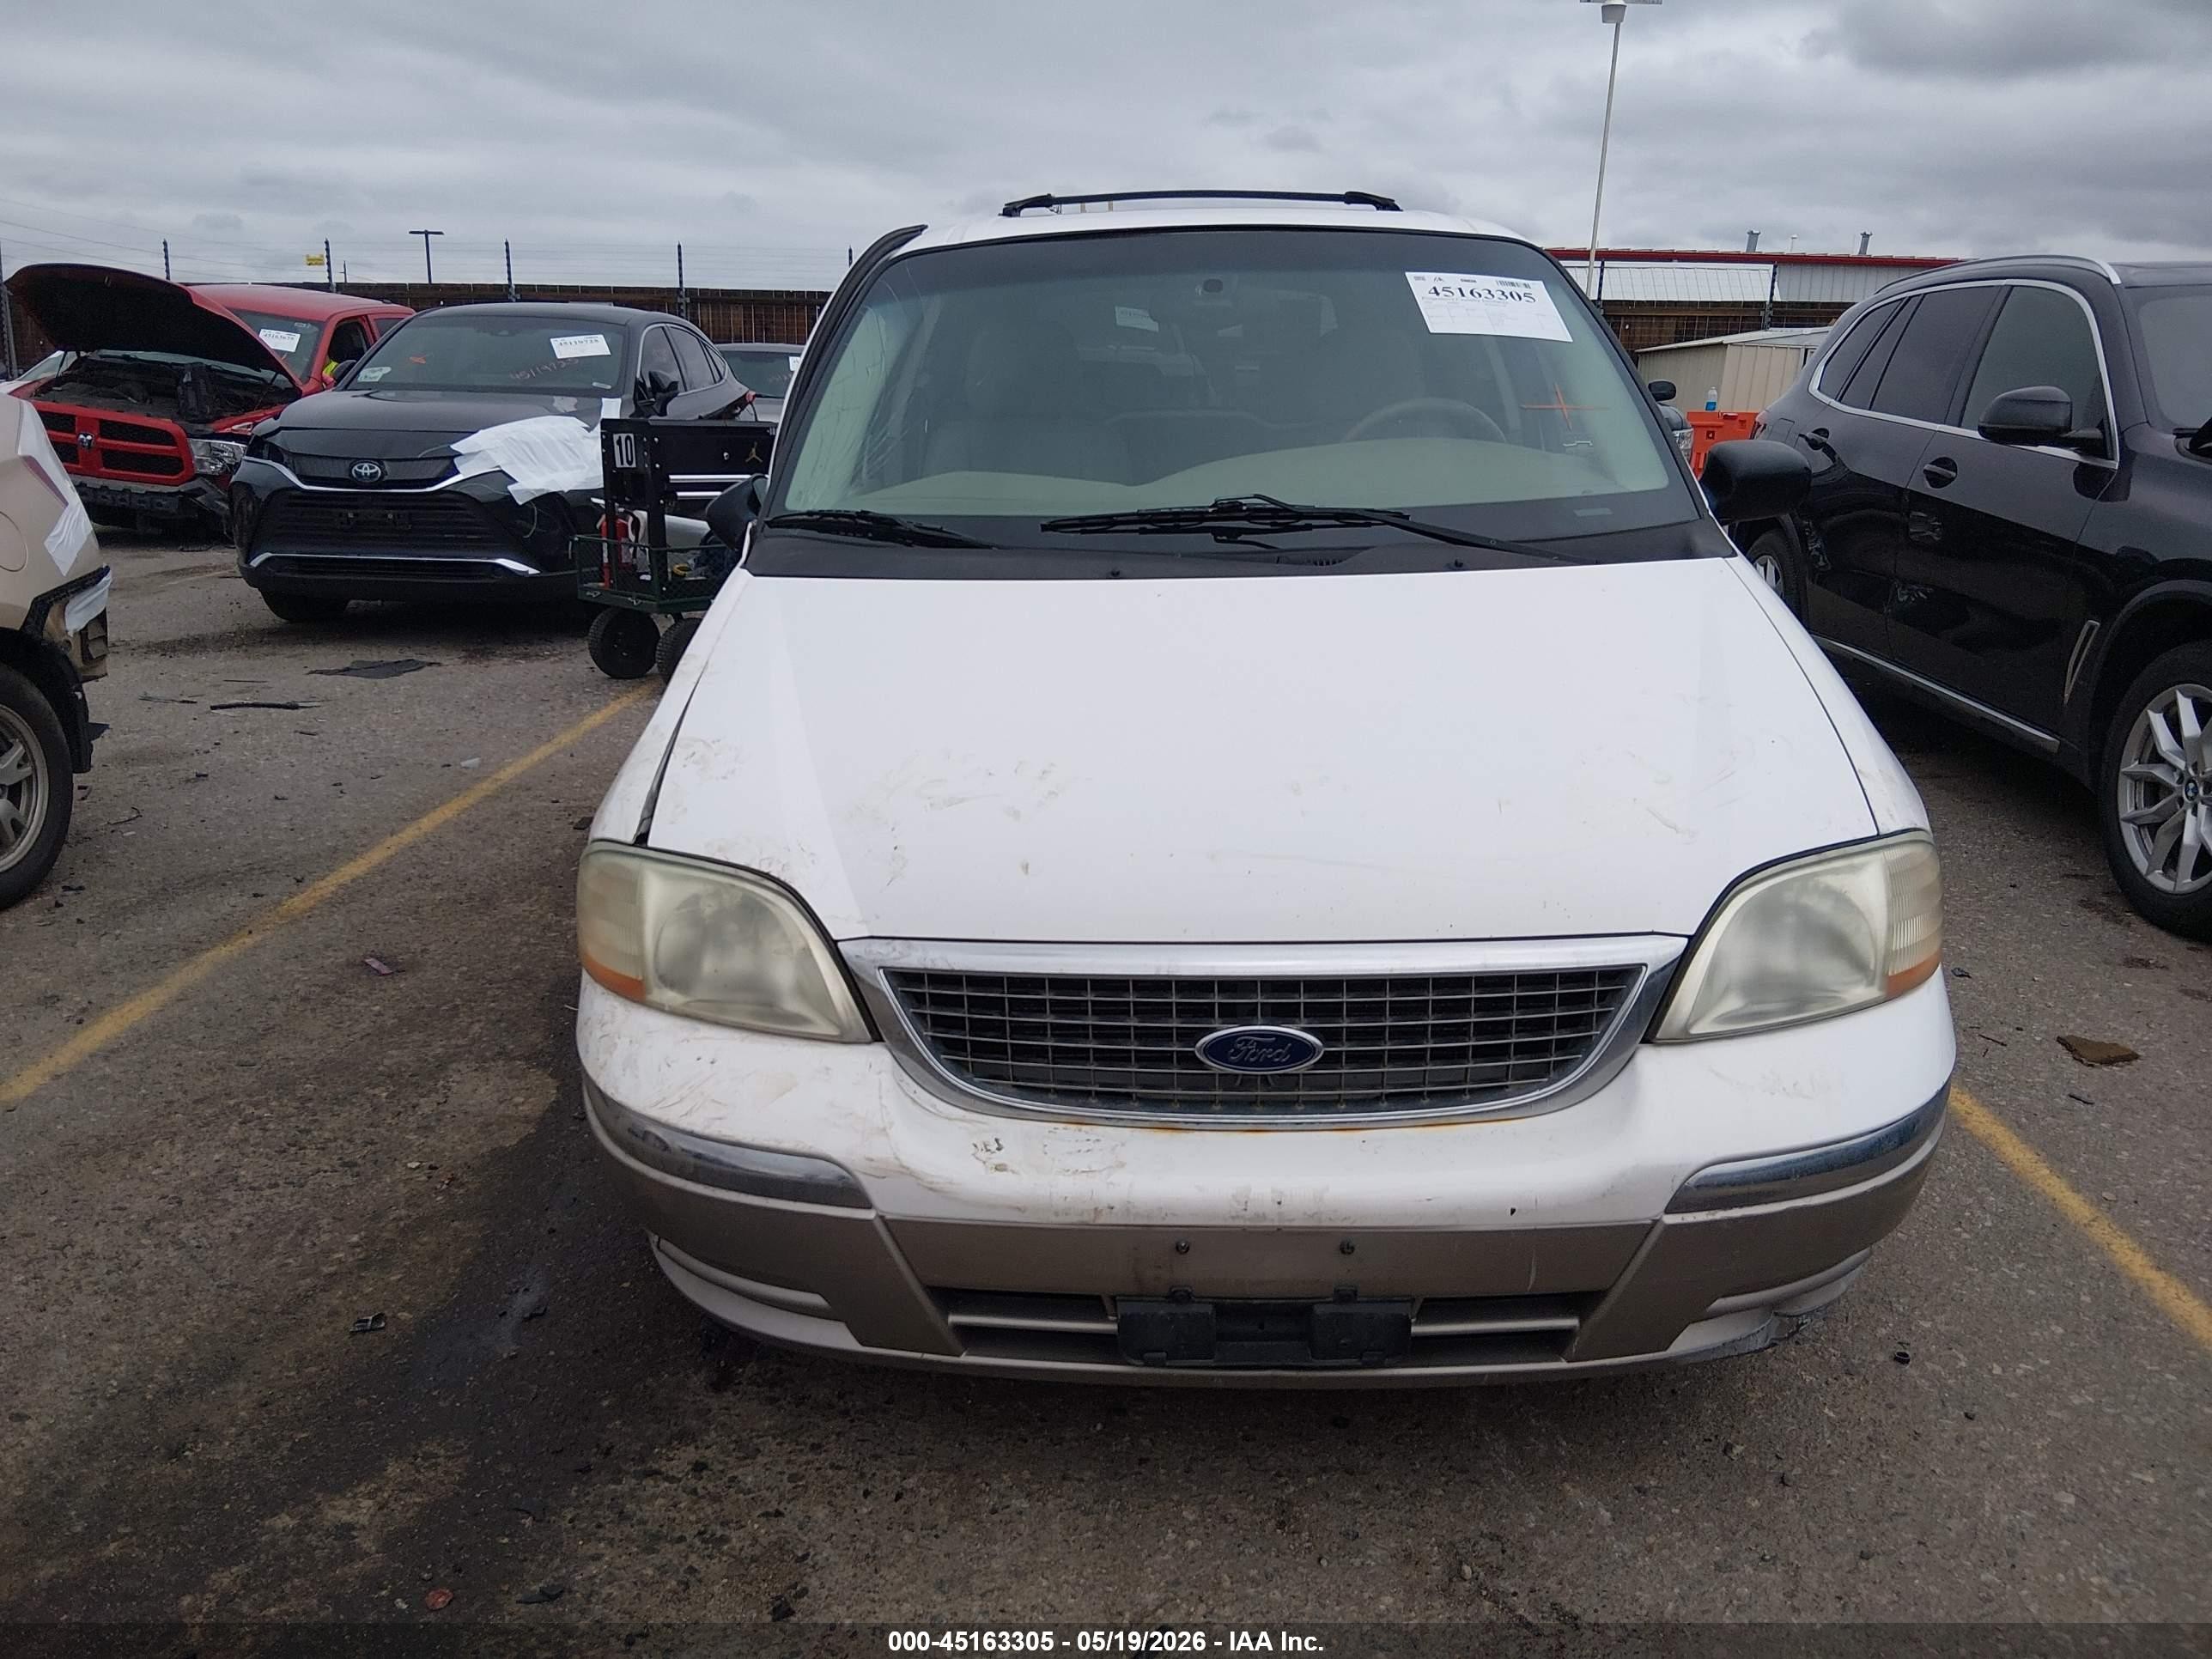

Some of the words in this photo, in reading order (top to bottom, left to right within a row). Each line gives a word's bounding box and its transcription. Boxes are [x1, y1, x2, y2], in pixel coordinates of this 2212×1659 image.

[1428, 285, 1537, 304] 45163305
[616, 434, 635, 466] 10
[1228, 1036, 1291, 1063] Ford
